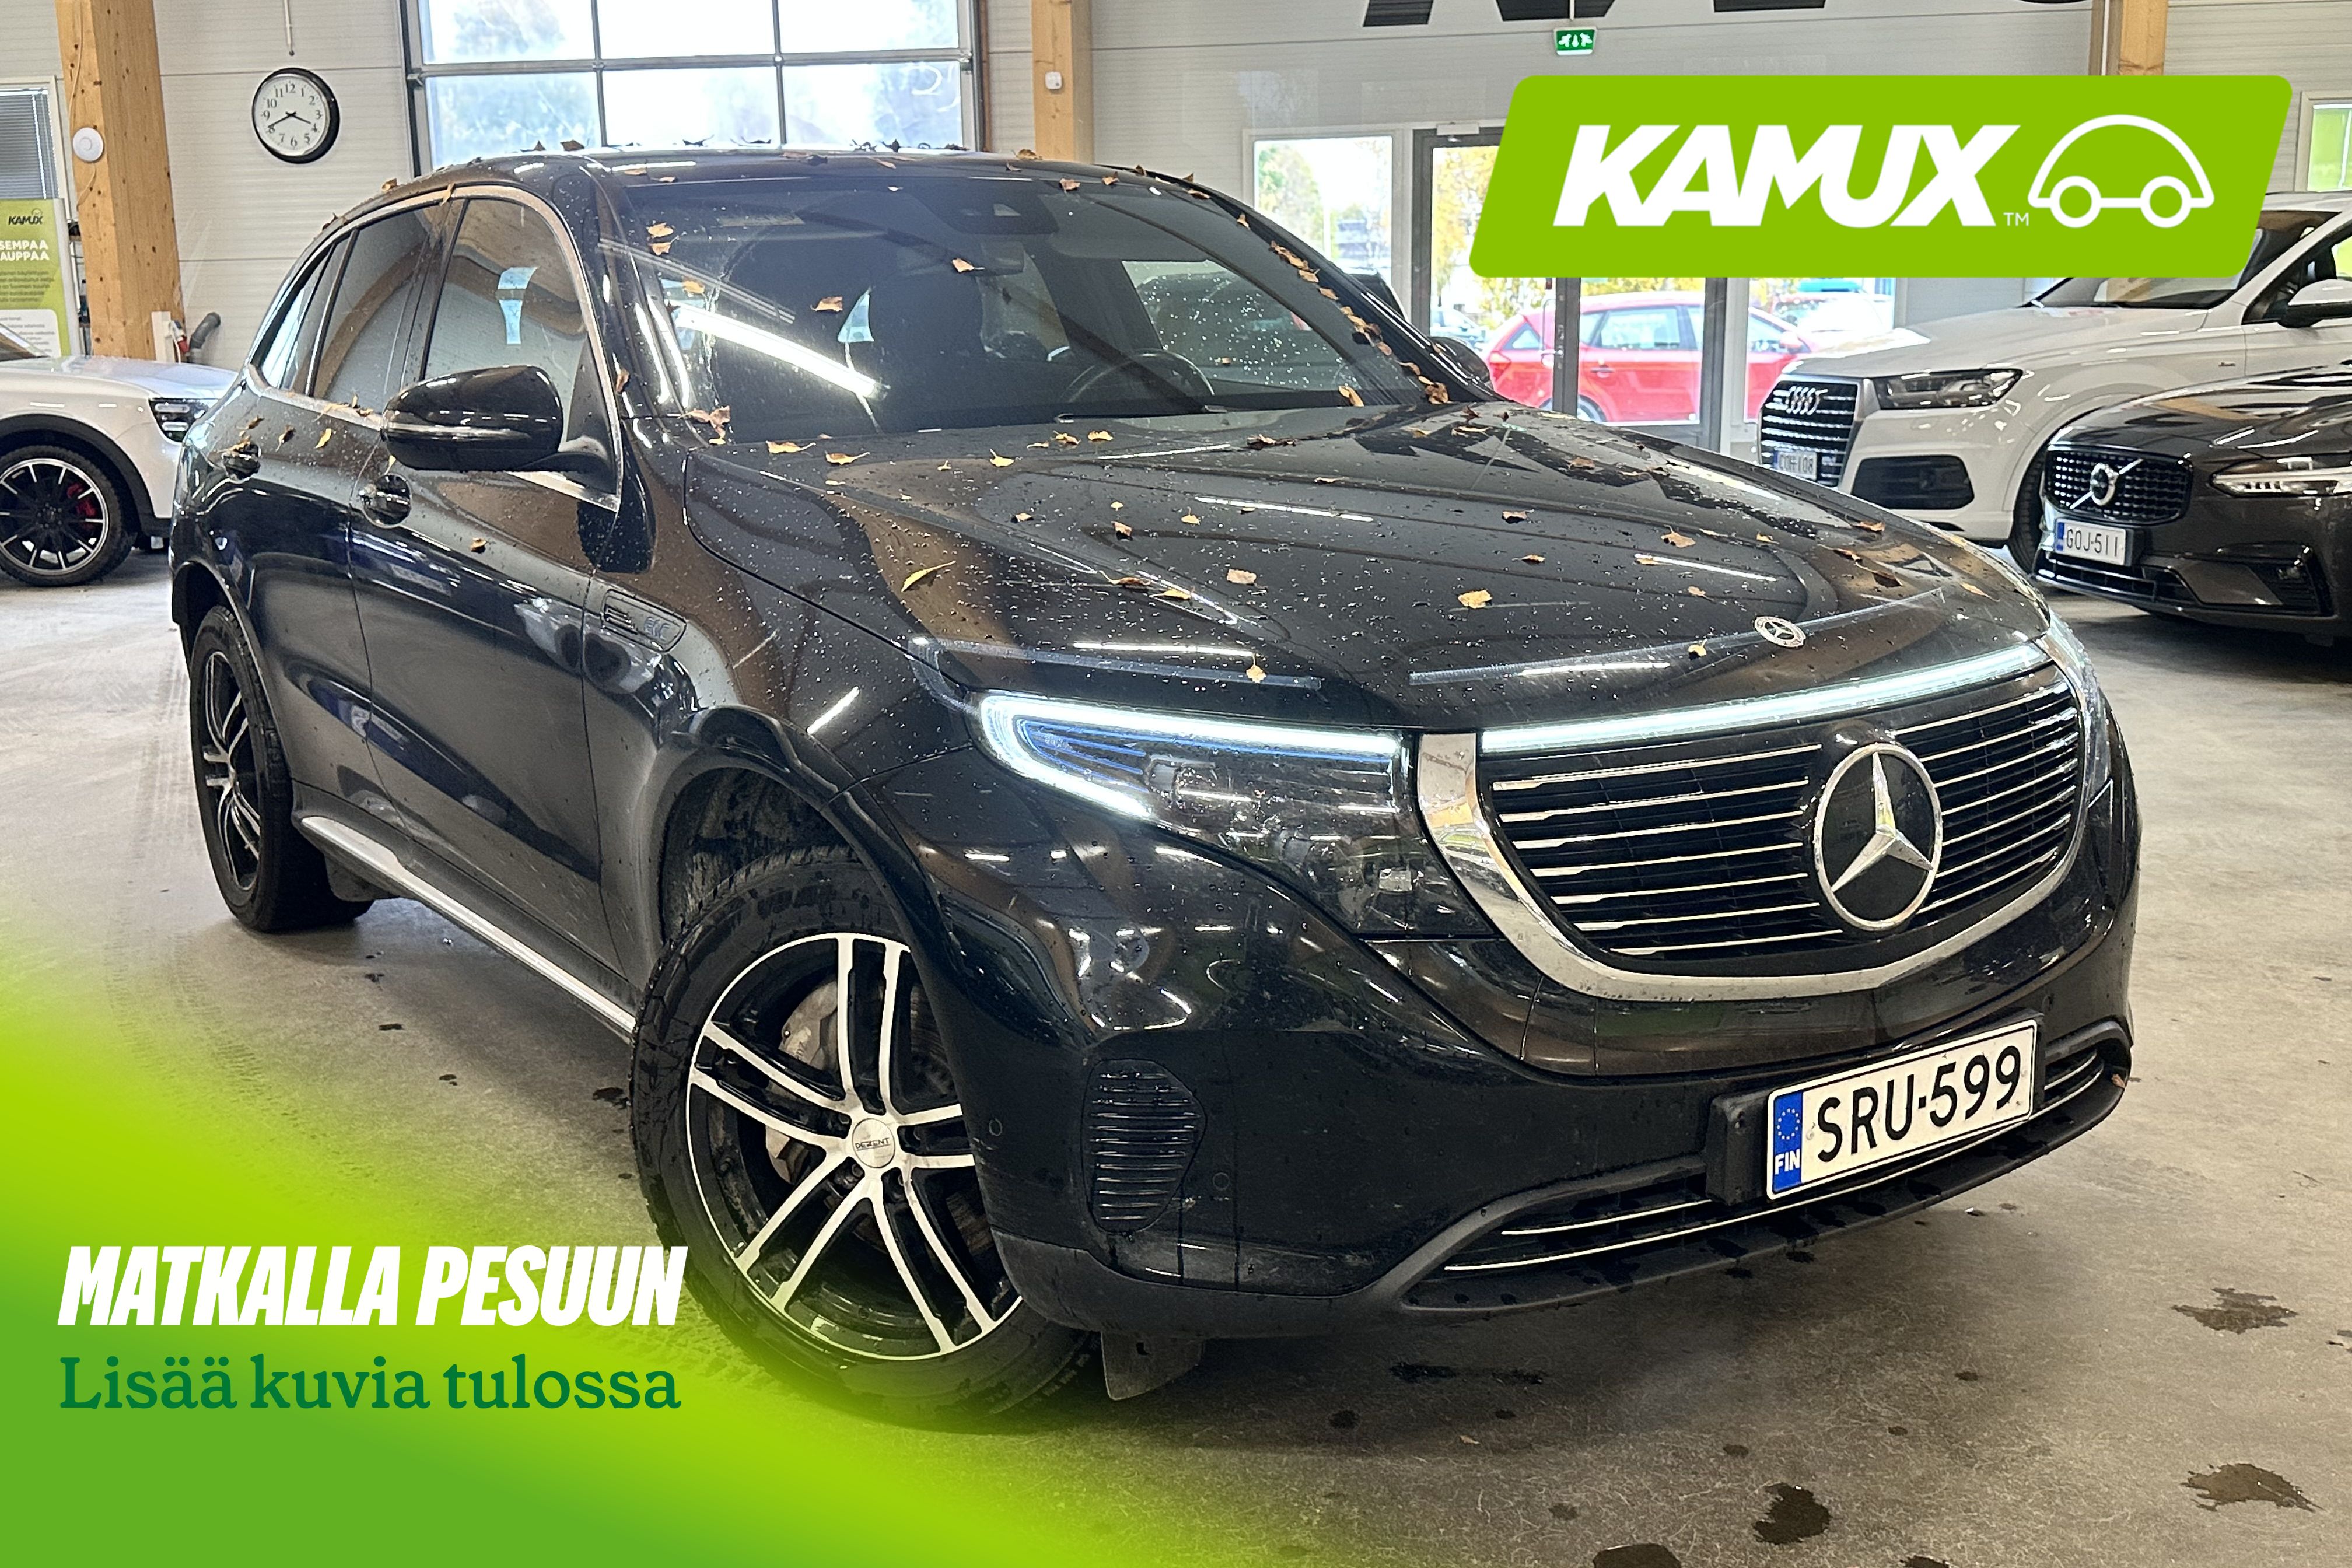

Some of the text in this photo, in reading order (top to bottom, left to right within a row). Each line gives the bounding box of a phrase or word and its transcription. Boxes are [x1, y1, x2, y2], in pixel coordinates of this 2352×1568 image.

[275, 88, 284, 98] 11
[285, 83, 296, 93] 12
[300, 88, 304, 97] 1
[267, 99, 277, 108] 10
[309, 96, 316, 106] 2
[262, 110, 270, 121] 9
[316, 110, 321, 119] 3
[268, 124, 275, 134] 8
[312, 123, 318, 132] 4
[279, 134, 285, 143] 7
[290, 136, 298, 146] 6
[304, 133, 310, 145] 5
[8, 215, 43, 225] KAMUX
[2066, 528, 2118, 556] GOJ-511
[1774, 1045, 2021, 1175] FIN SRU-599
[855, 1137, 890, 1150] DEZENT
